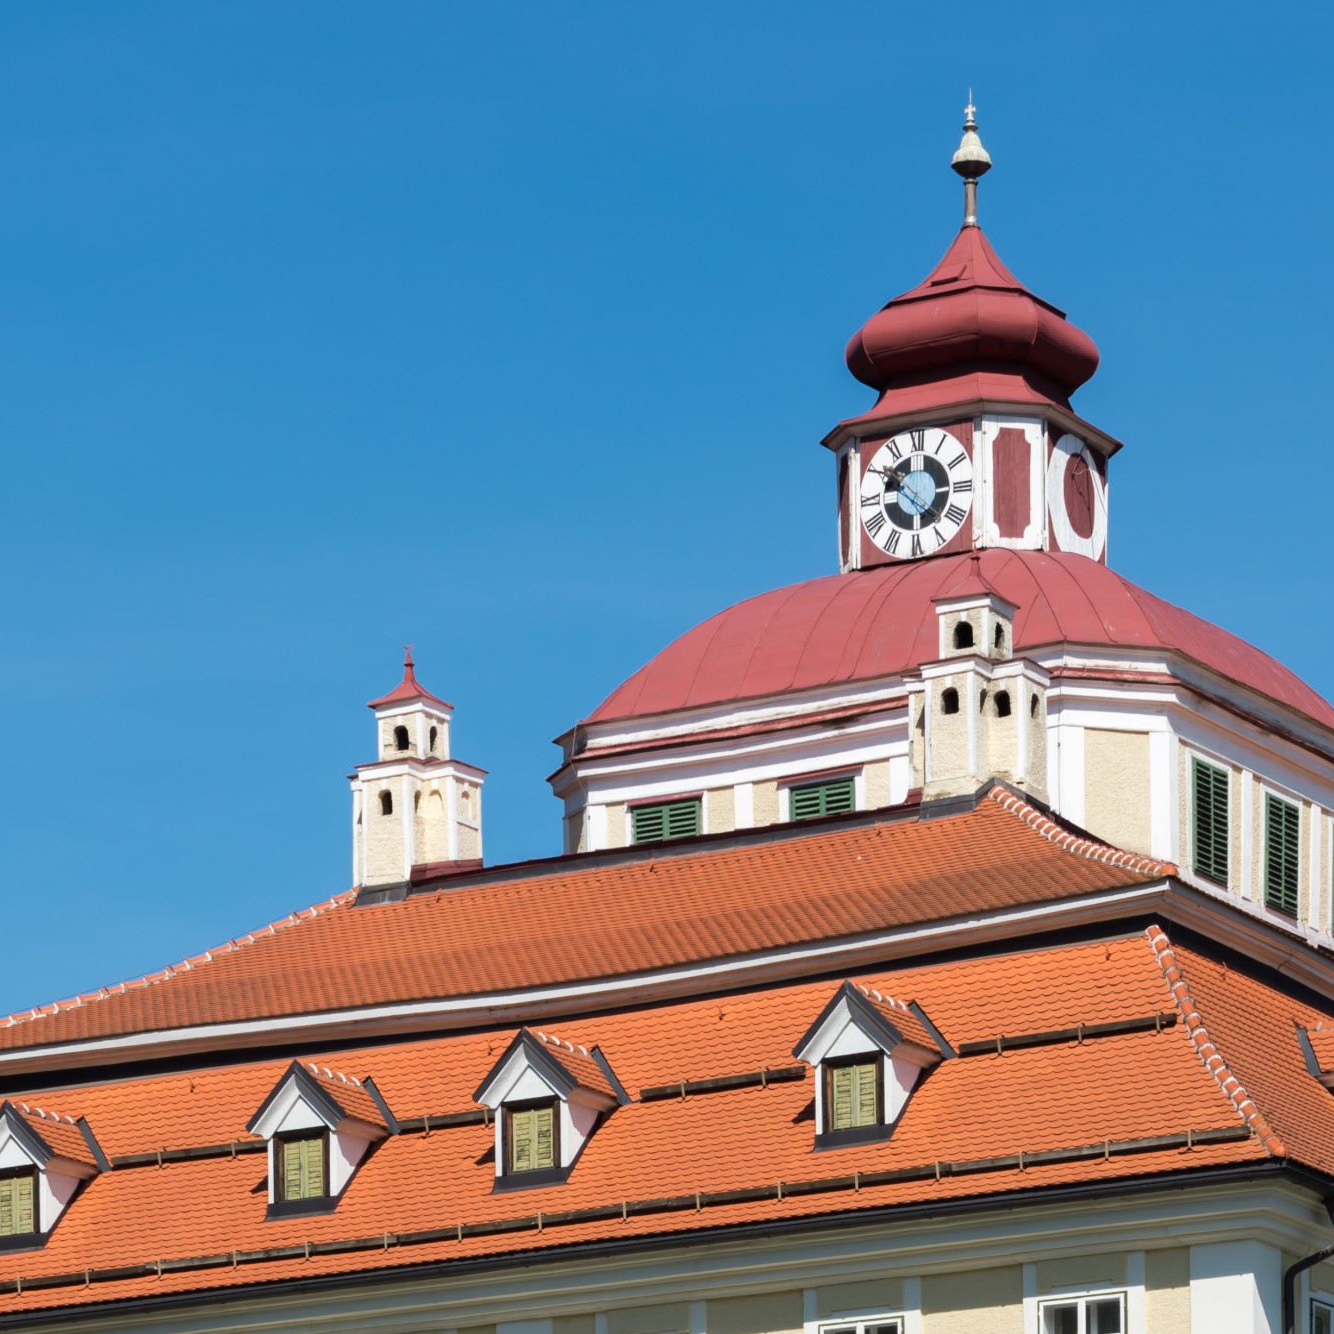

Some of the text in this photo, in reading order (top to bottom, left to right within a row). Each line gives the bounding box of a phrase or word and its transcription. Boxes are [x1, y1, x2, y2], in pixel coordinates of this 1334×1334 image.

[886, 438, 902, 463] XI
[910, 430, 924, 452] XII
[935, 433, 948, 455] I
[948, 452, 967, 470] II
[953, 480, 972, 493] III
[861, 493, 880, 507] IX
[865, 510, 887, 539] VIII
[883, 528, 902, 554] VII
[911, 534, 924, 557] VI
[933, 526, 947, 547] V
